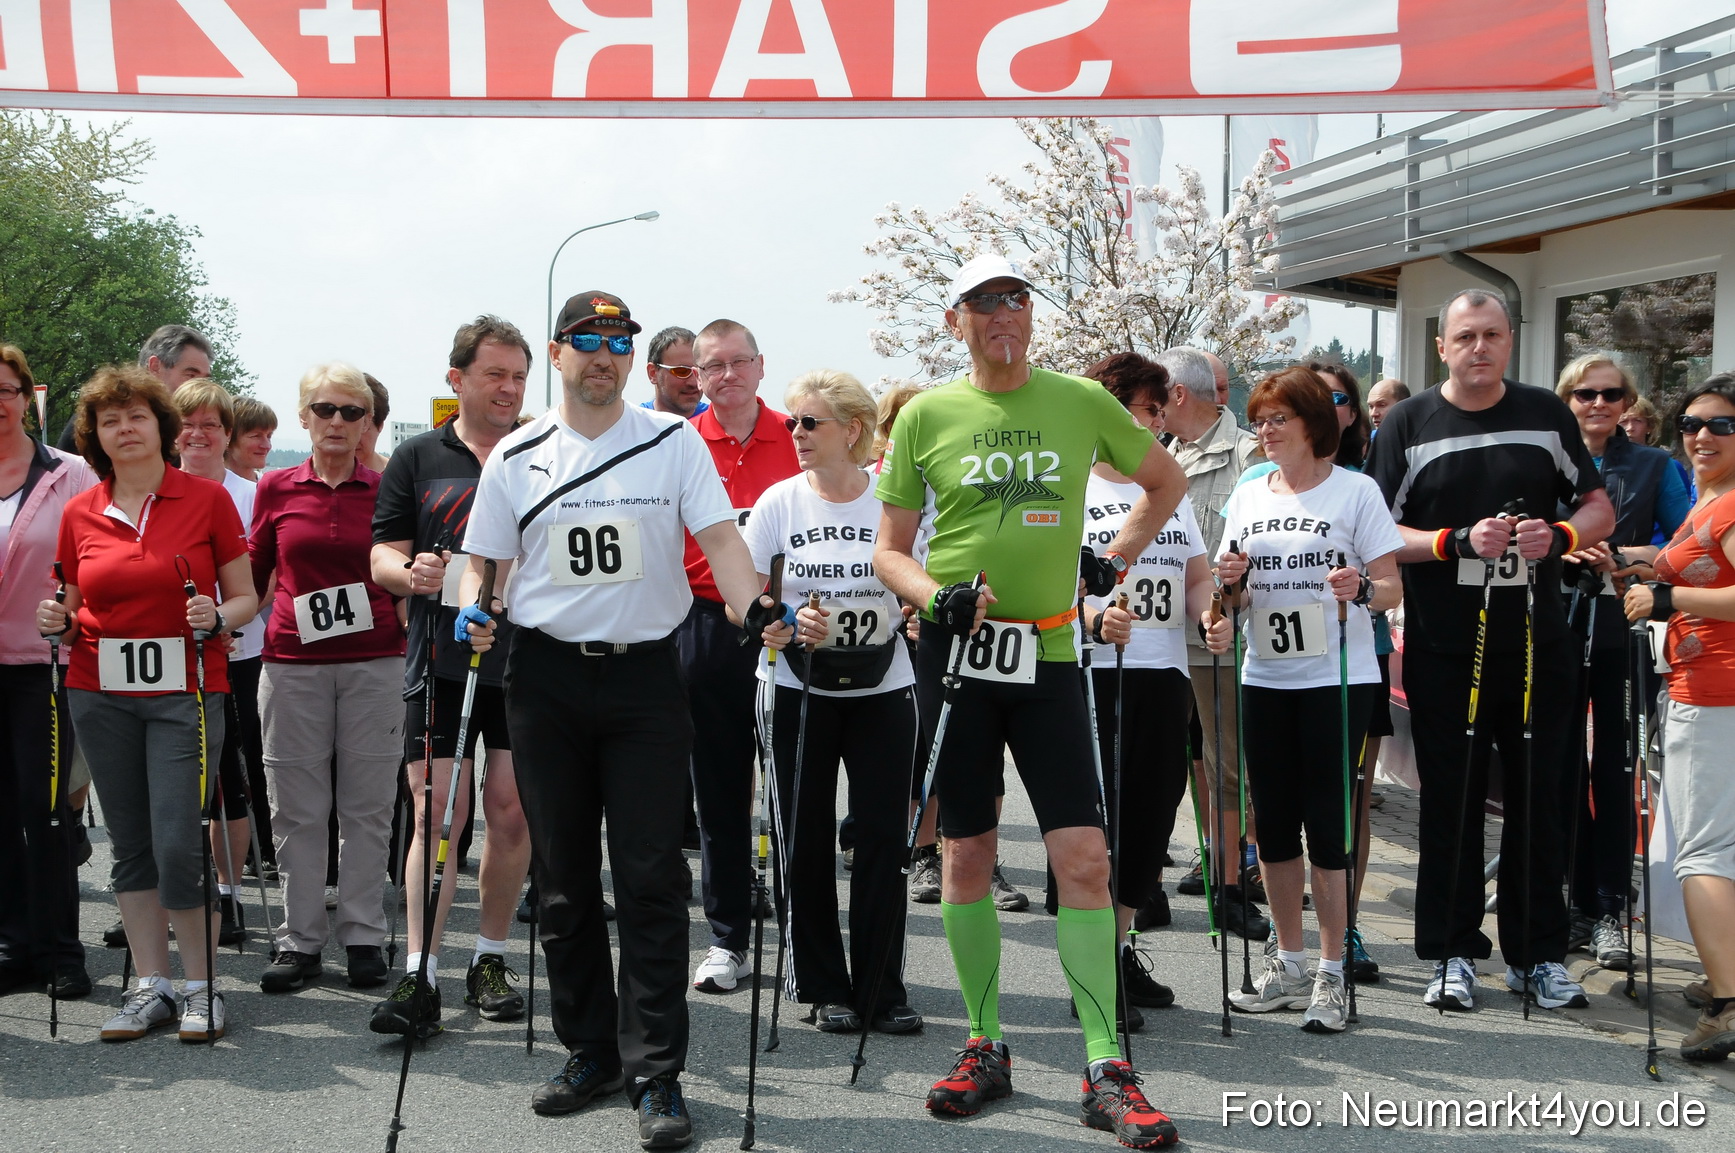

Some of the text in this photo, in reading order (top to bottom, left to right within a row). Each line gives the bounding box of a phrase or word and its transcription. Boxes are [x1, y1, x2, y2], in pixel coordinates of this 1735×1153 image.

[973, 429, 1041, 449] FÜRTH
[960, 450, 1061, 486] 2012
[561, 496, 671, 509] www.fitness-neumarkt.de
[1026, 513, 1058, 523] OBI
[1240, 517, 1332, 541] BERGER
[790, 525, 878, 549] BERGE
[1155, 530, 1191, 547] GIRL
[567, 524, 622, 576] 96
[1287, 549, 1334, 570] GIRLS
[788, 563, 845, 579] POWER
[1141, 556, 1157, 565] and
[1160, 556, 1184, 571] talking
[834, 589, 852, 598] and
[854, 589, 885, 598] talking
[1272, 581, 1290, 590] and
[1292, 580, 1324, 591] talking
[308, 587, 356, 632] 84
[1134, 578, 1172, 622] 33
[835, 609, 878, 647] 32
[1268, 611, 1305, 654] 31
[967, 621, 1023, 675] 80
[120, 641, 163, 684] 10
